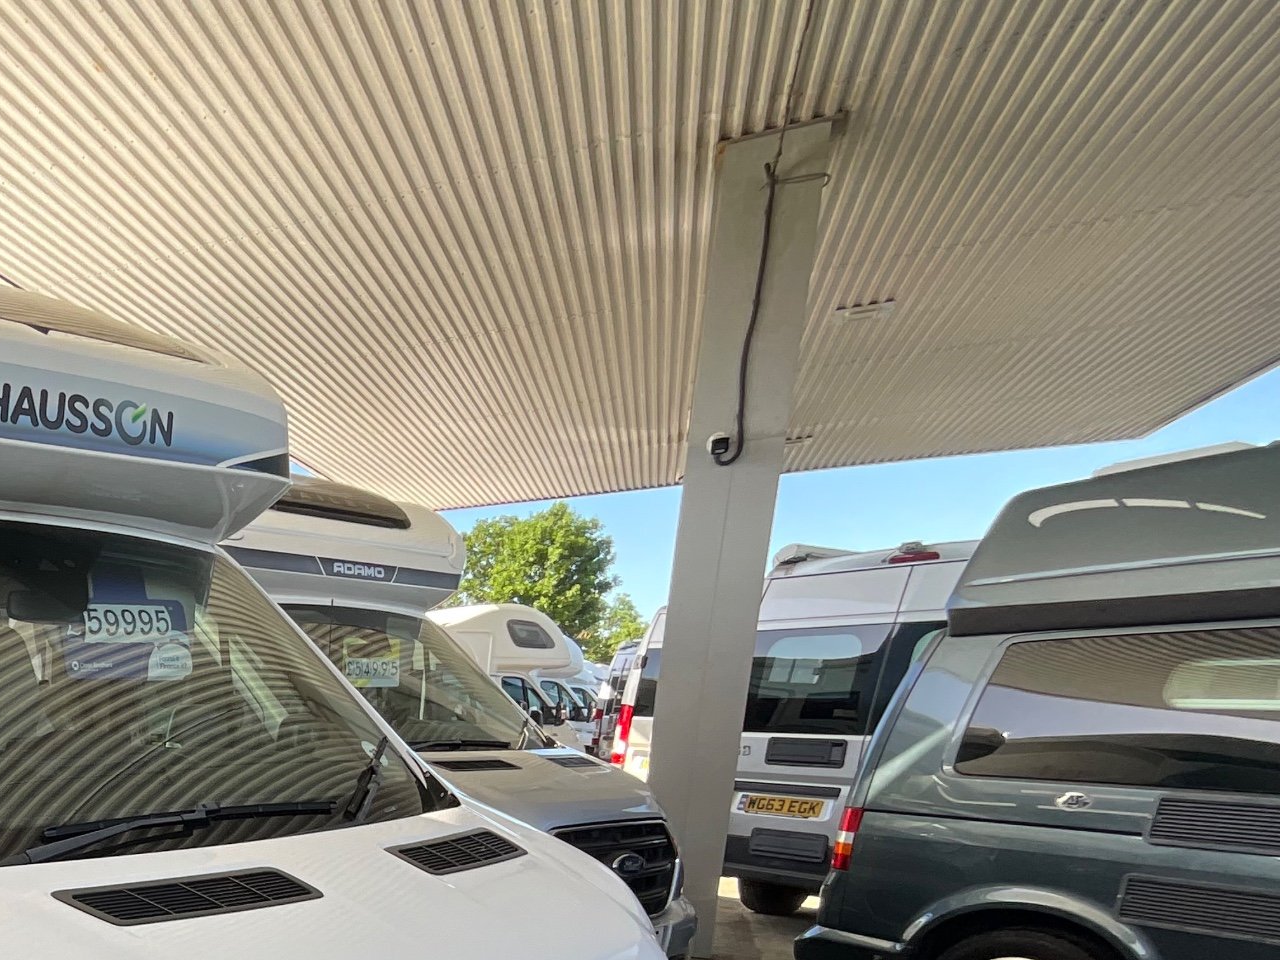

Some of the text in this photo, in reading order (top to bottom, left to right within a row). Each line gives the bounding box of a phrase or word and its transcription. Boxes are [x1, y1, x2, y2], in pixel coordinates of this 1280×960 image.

[333, 562, 385, 578] ADAMO
[86, 608, 170, 636] 59995
[787, 800, 820, 815] EGK
